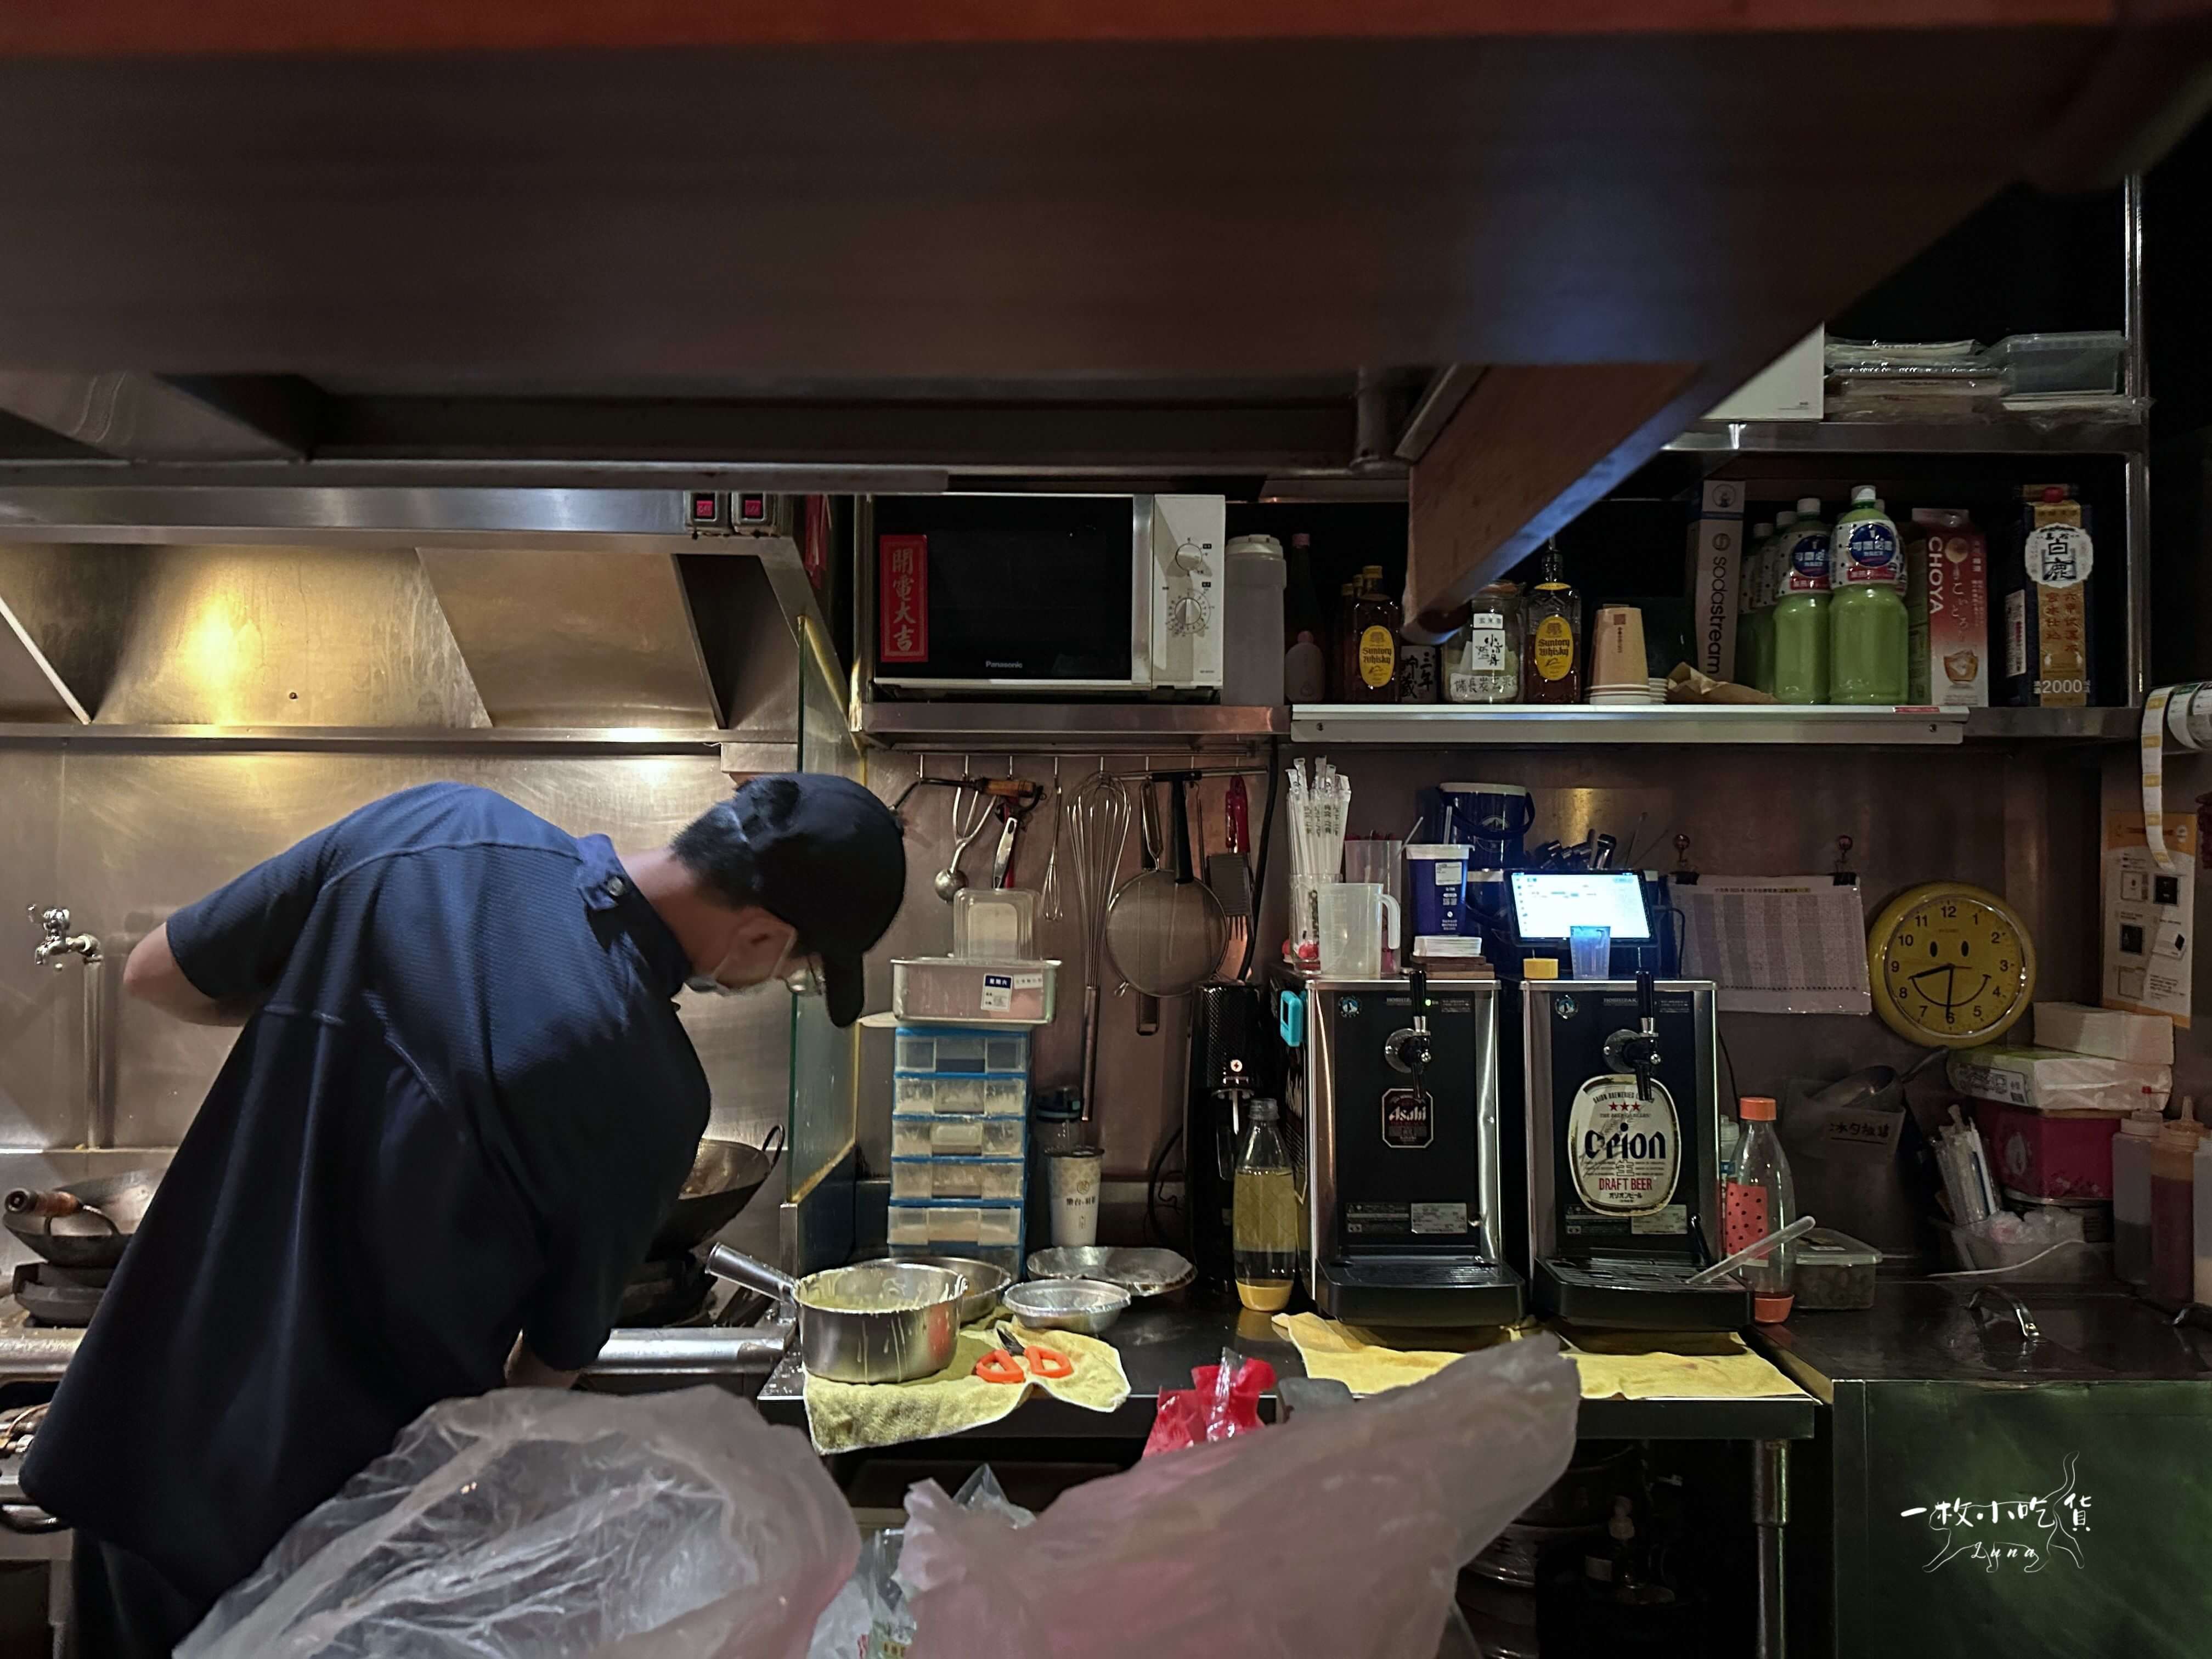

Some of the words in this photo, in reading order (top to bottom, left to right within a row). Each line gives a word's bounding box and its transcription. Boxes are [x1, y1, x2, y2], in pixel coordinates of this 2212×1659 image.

[2042, 538, 2077, 581] 白鹿
[1928, 535, 1944, 614] CHOYA
[893, 548, 917, 652] 開電大吉
[1707, 556, 1727, 674] sodastream
[1538, 639, 1570, 647] Suntory
[1362, 648, 1392, 656] Suntory
[1538, 647, 1569, 657] Whisky
[985, 659, 1023, 669] Panasonic
[1363, 656, 1391, 664] Whisky
[2042, 680, 2083, 693] 2000
[1940, 906, 1957, 918] 12
[1915, 915, 1928, 927] 11
[1972, 913, 1978, 925] 1
[1898, 934, 1914, 946] 10
[1991, 932, 2000, 944] 2
[1891, 961, 1900, 973] 9
[2000, 960, 2008, 972] 3
[1899, 987, 1908, 998] 8
[1993, 986, 2001, 997] 4
[1919, 1005, 1928, 1017] 7
[1974, 1005, 1982, 1017] 5
[1947, 1013, 1955, 1024] 6
[1388, 1105, 1426, 1121] Asahi
[1584, 1122, 1666, 1159] Orion
[1615, 1159, 1635, 1177] 生
[1599, 1178, 1628, 1190] DRAFT
[1630, 1178, 1653, 1190] BEER
